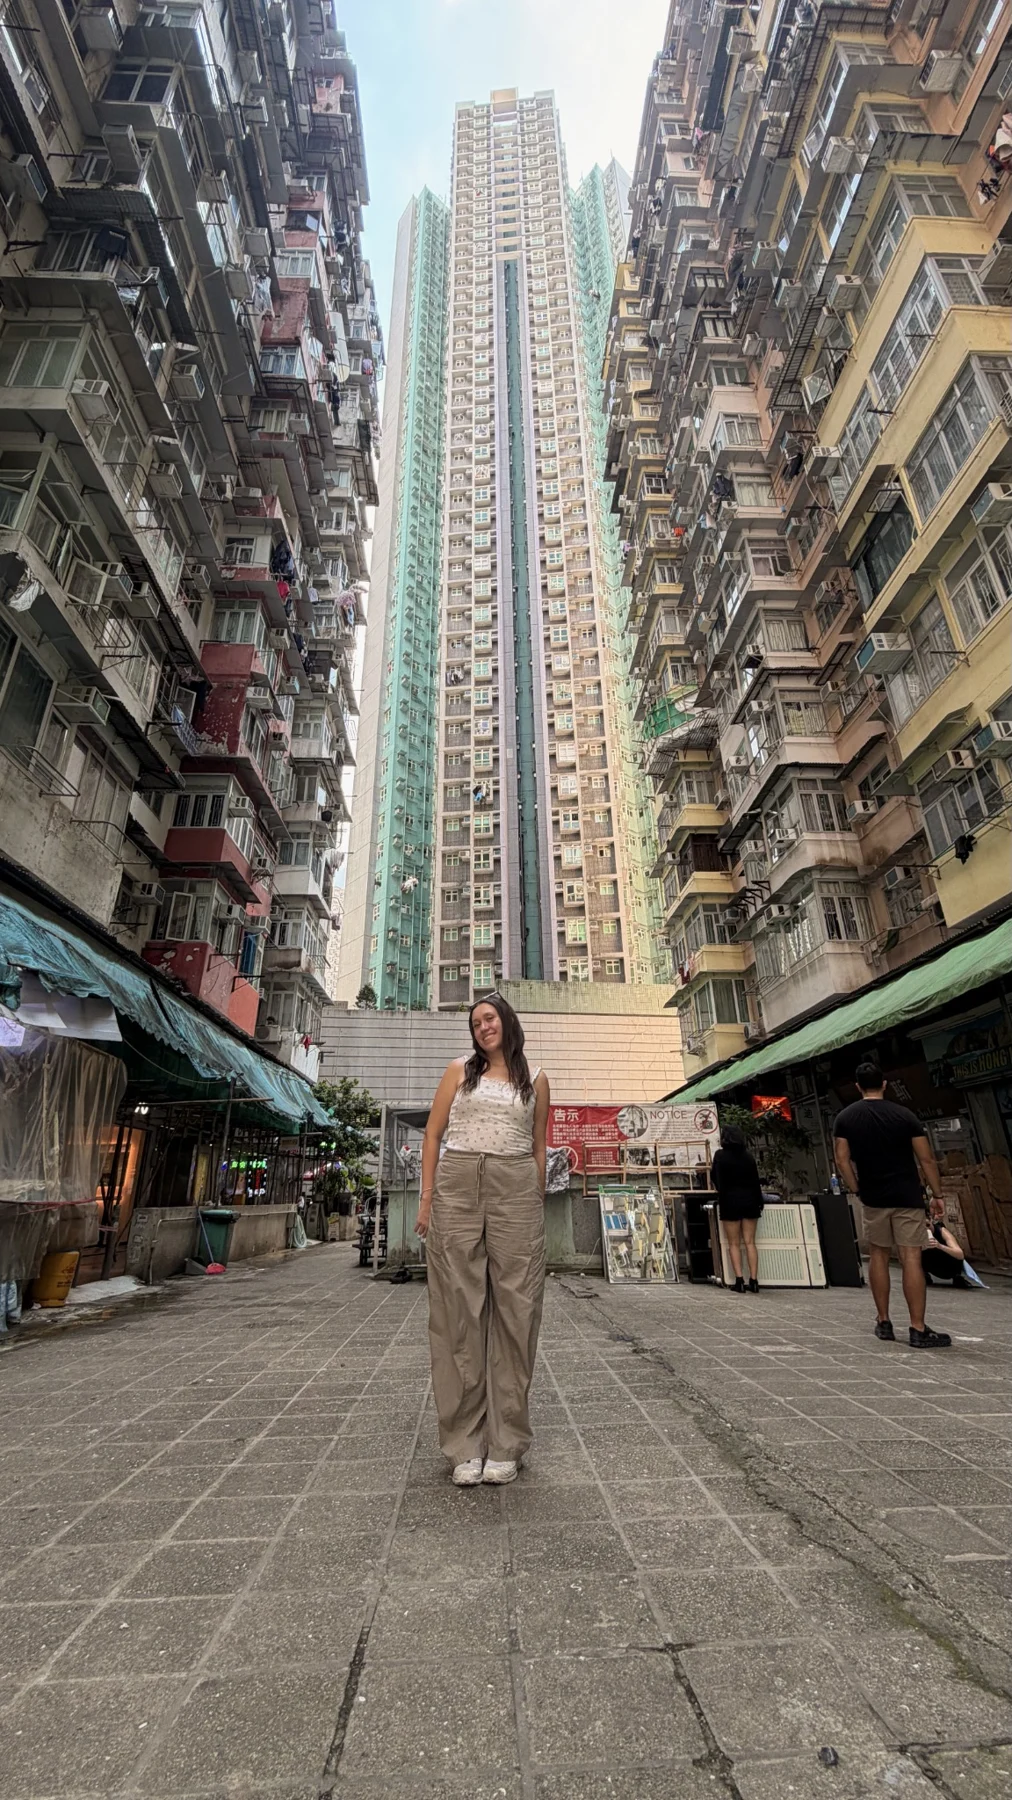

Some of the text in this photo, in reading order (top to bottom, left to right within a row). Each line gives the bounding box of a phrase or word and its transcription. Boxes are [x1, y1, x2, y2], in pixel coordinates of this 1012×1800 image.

[953, 1063, 969, 1078] THIS
[970, 1060, 978, 1074] IS
[979, 1049, 1007, 1071] HONG
[553, 1108, 579, 1122] 告示
[650, 1110, 688, 1120] NOTICE
